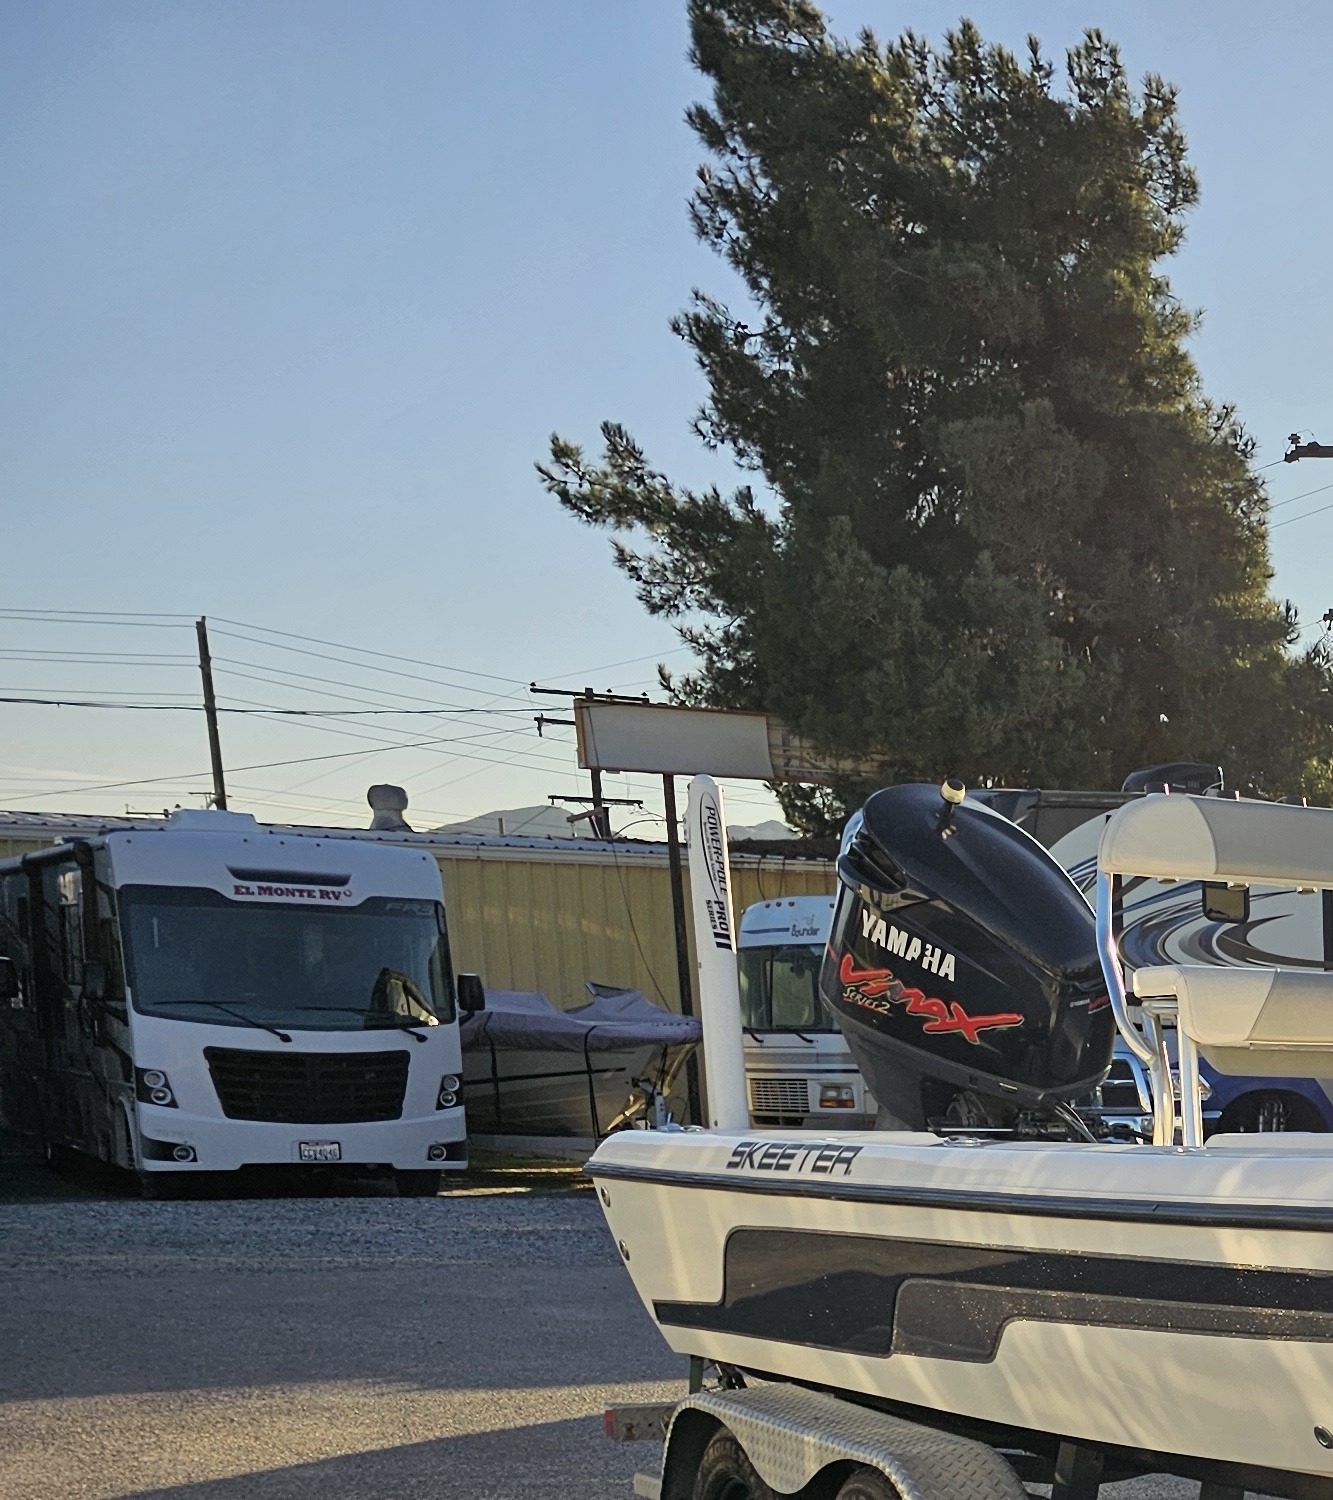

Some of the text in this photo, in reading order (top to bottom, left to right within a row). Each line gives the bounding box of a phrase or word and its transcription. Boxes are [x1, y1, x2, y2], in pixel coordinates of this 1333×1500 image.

[705, 805, 728, 895] POWER-POLE
[233, 885, 343, 901] EL MONTE RV
[705, 899, 719, 930] SERIES
[713, 900, 730, 932] PRO
[861, 908, 956, 982] YAMAHA
[726, 1141, 865, 1176] SKEETER
